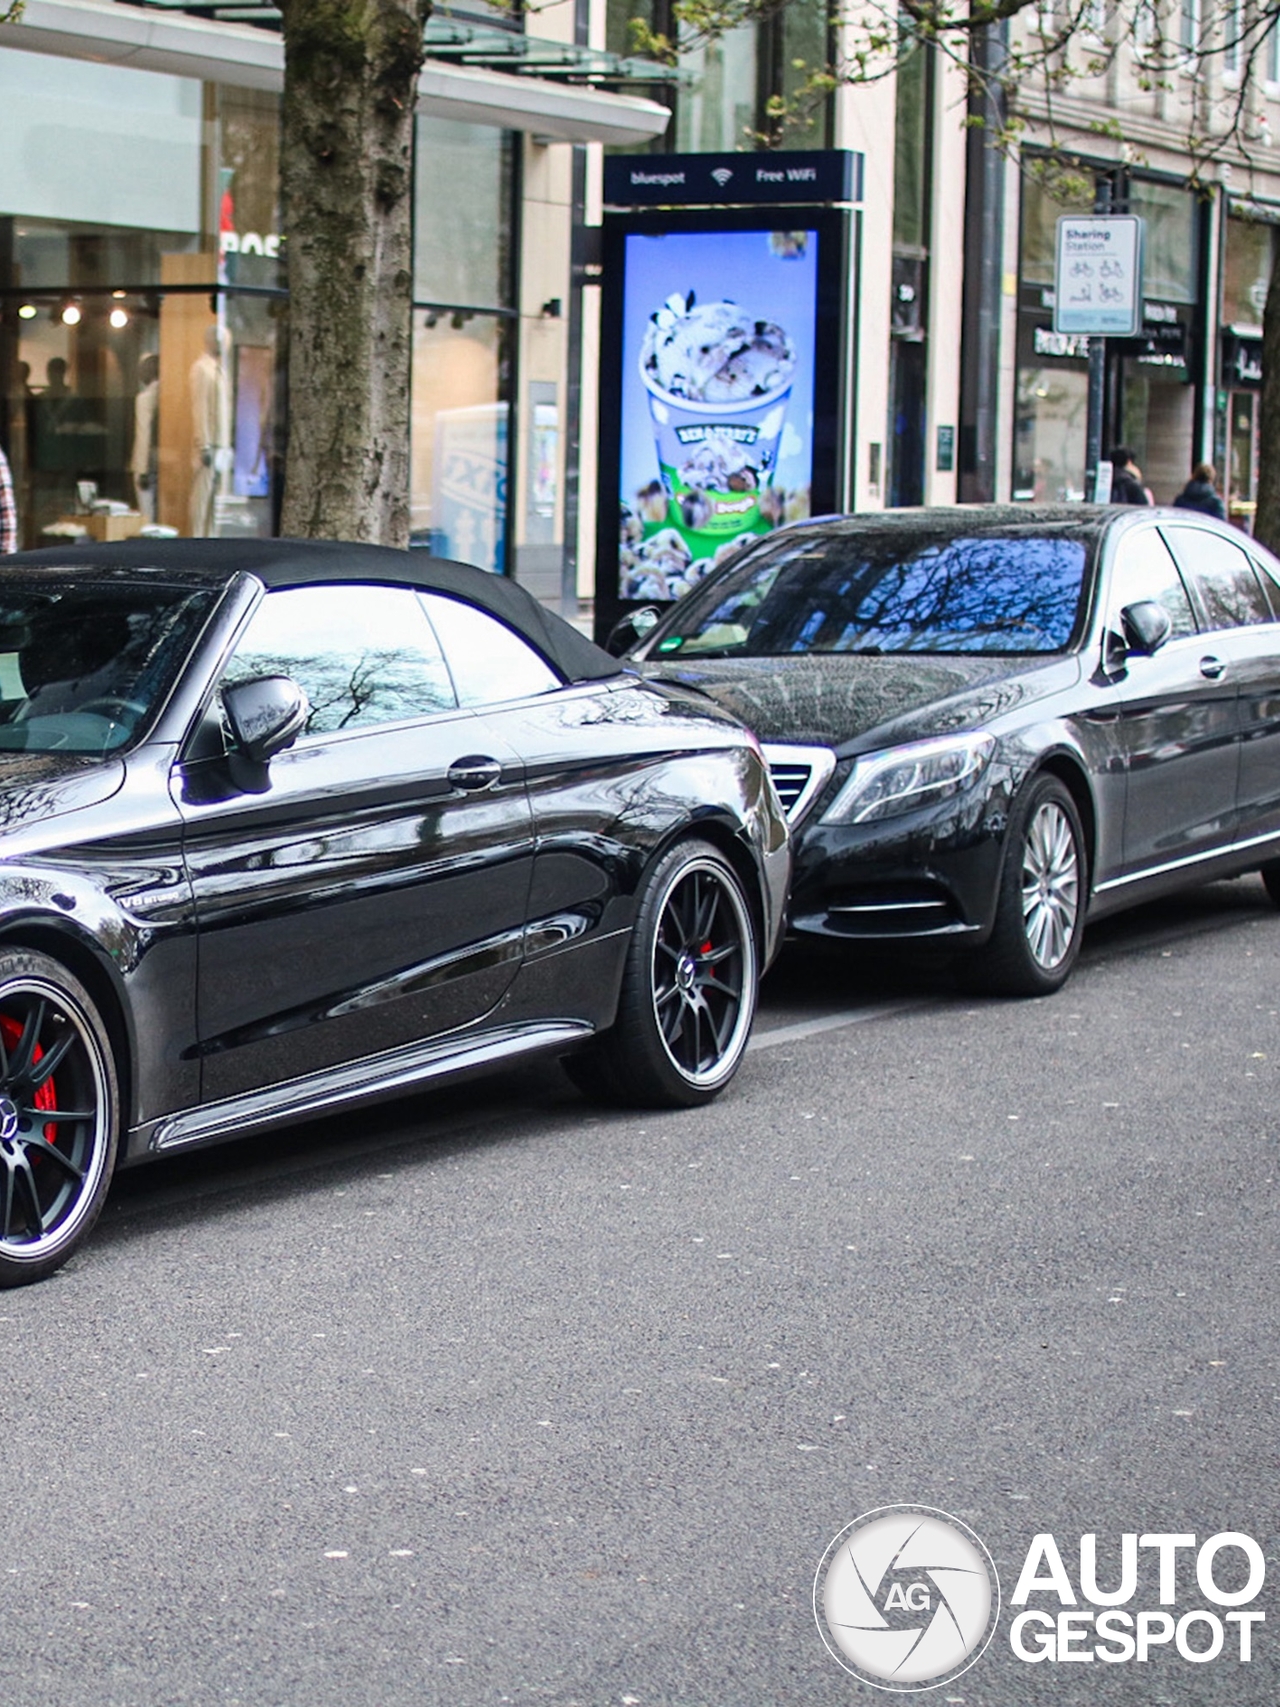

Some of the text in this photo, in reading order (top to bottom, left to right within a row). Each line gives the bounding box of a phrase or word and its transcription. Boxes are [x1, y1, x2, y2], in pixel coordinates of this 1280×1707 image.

[630, 171, 686, 187] bluespot
[755, 167, 817, 182] Free WiFi
[1066, 229, 1111, 241] Sharing
[1065, 241, 1106, 252] Station
